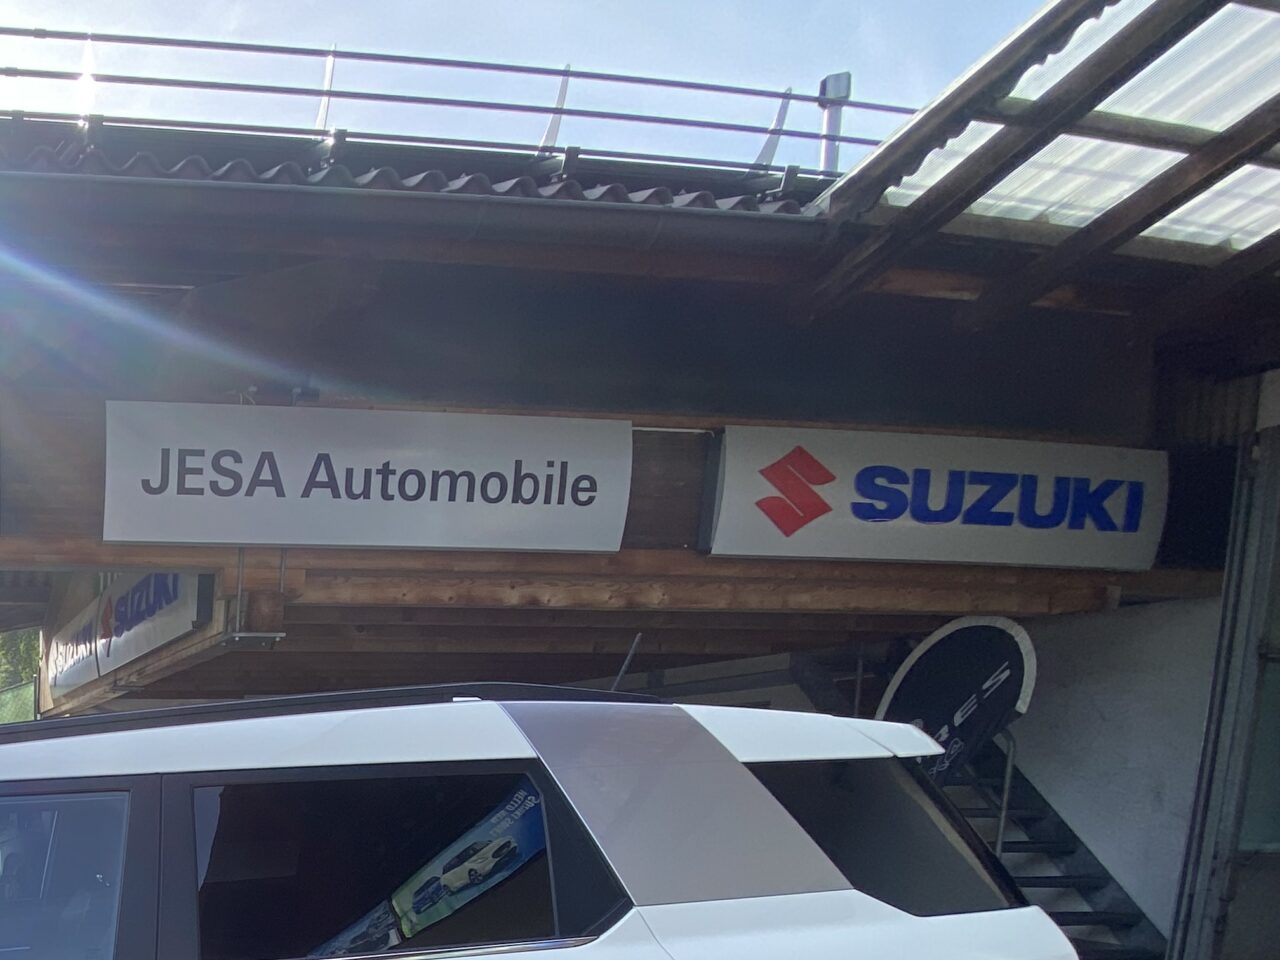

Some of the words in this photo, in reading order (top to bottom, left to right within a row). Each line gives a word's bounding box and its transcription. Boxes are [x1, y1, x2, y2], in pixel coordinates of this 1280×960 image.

[140, 447, 287, 499] JESA
[300, 452, 598, 507] Automobile
[850, 464, 1145, 533] SUZUKI
